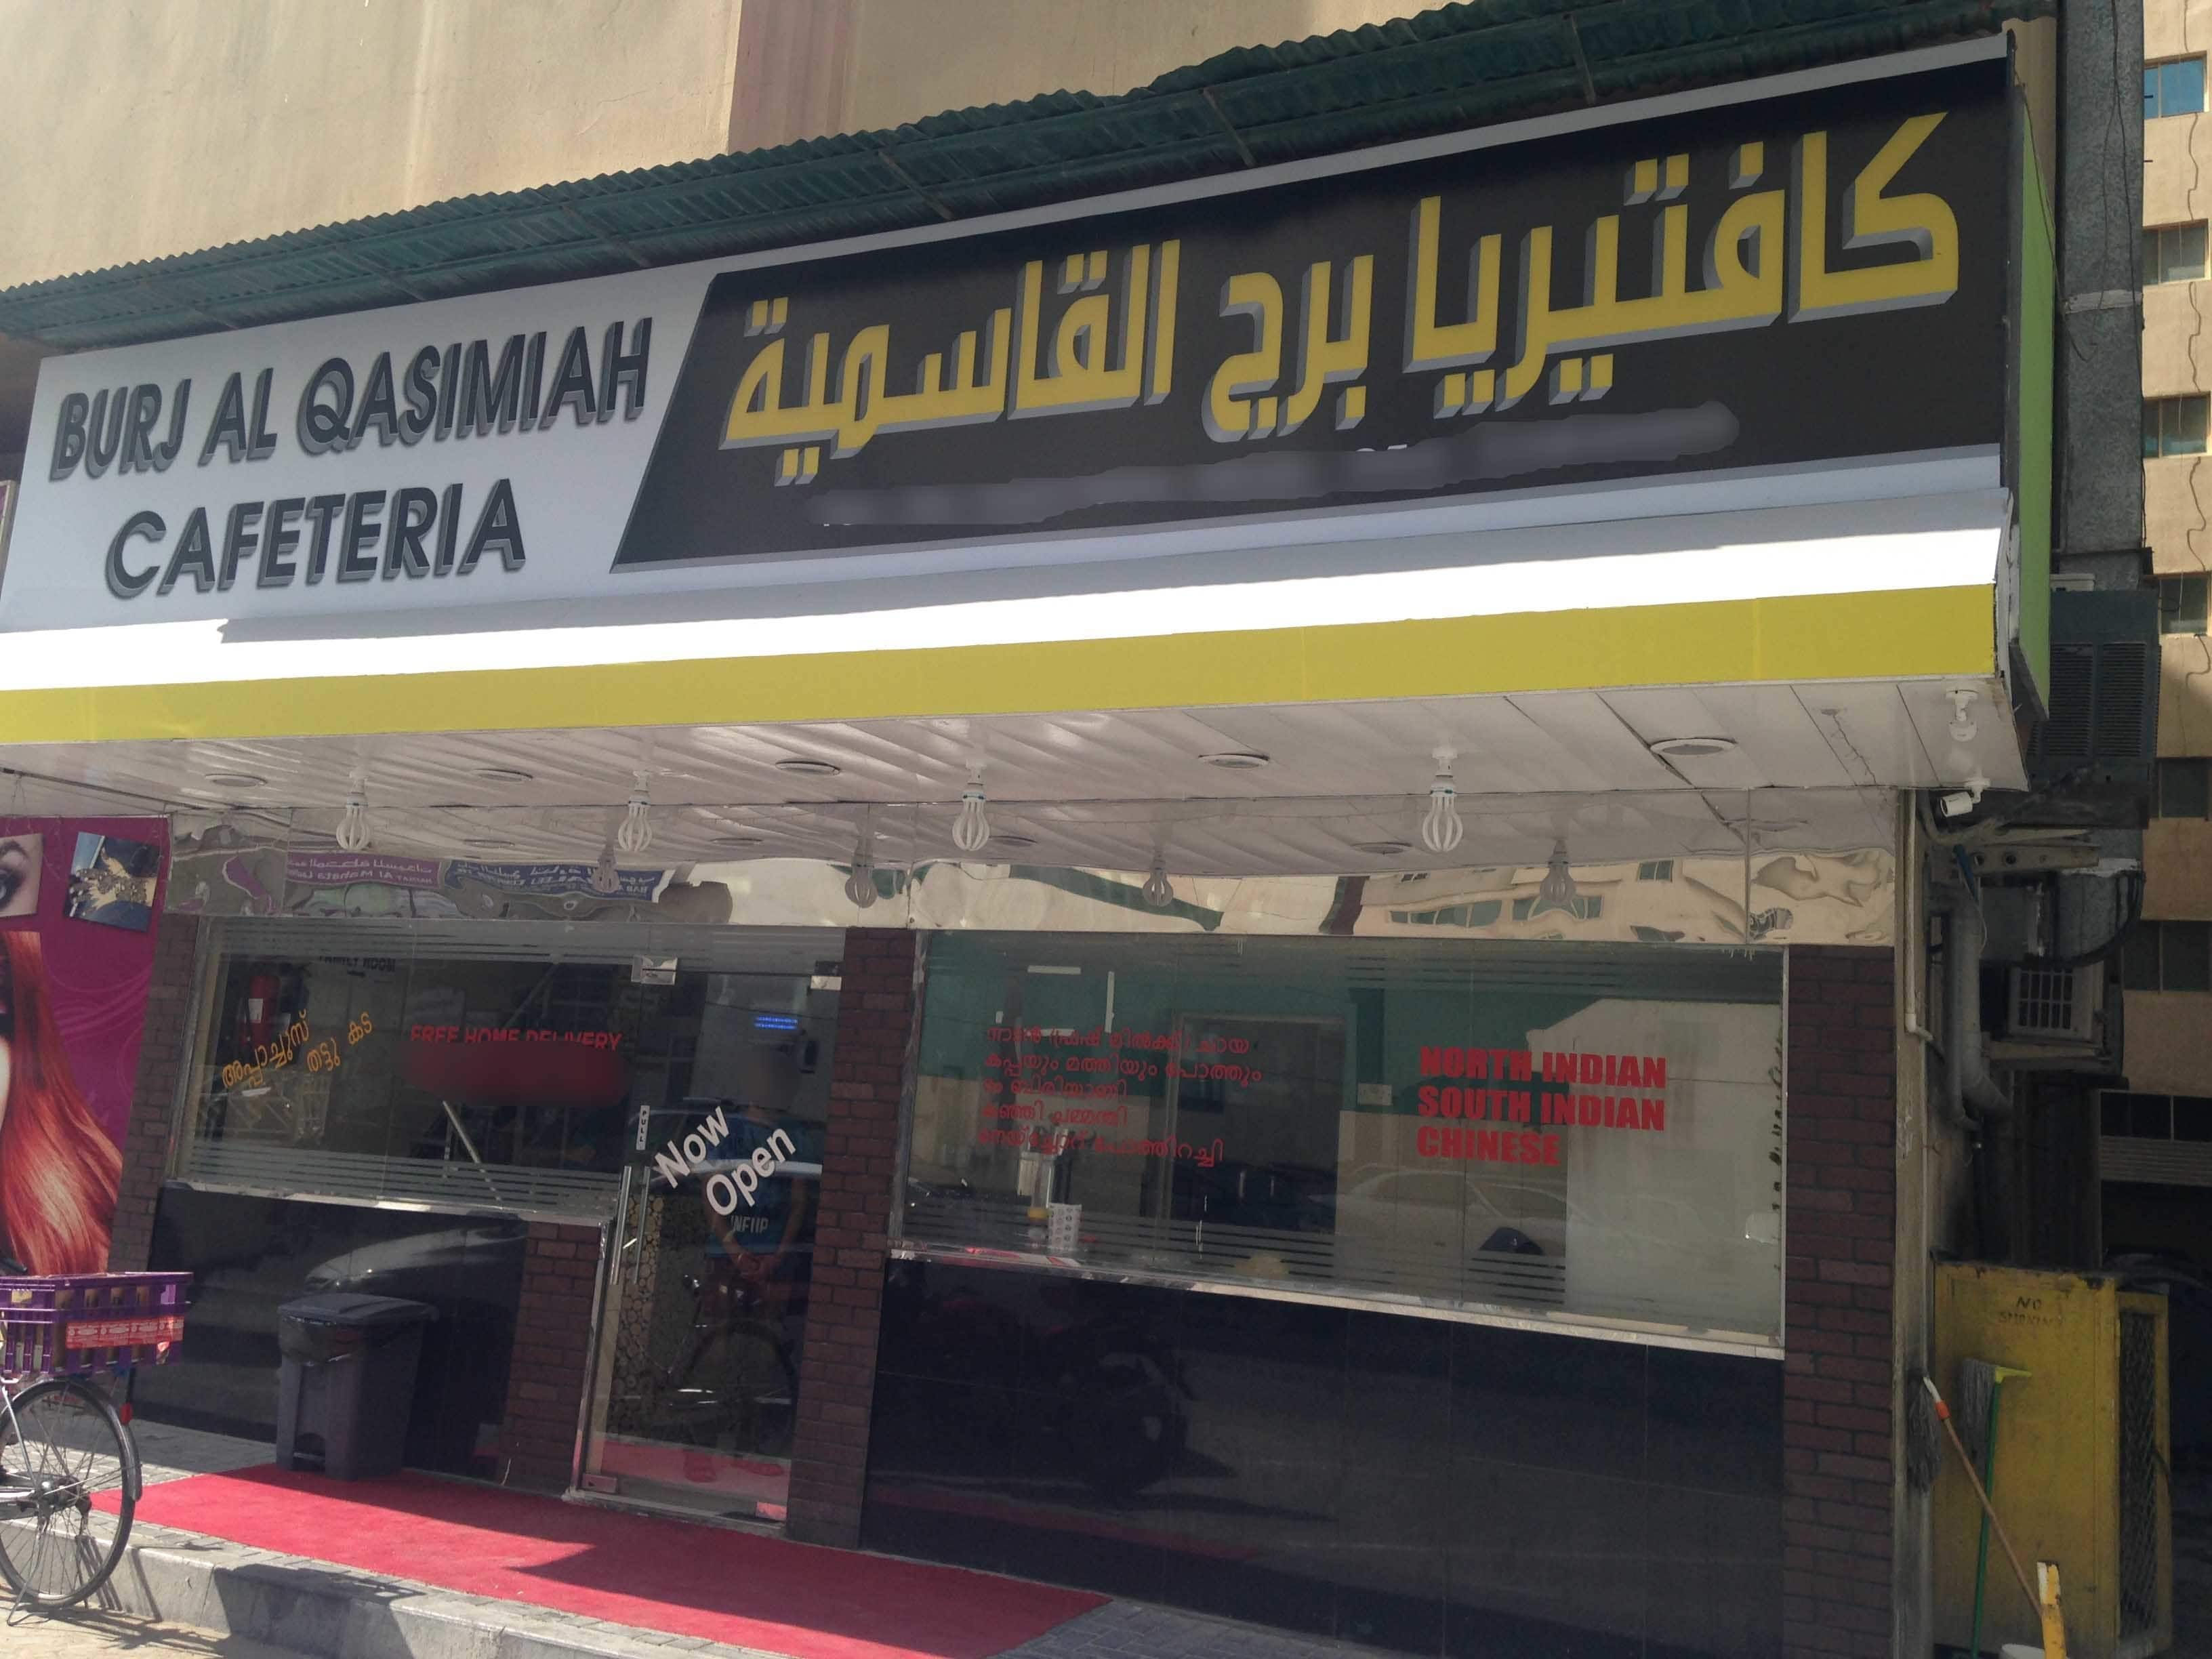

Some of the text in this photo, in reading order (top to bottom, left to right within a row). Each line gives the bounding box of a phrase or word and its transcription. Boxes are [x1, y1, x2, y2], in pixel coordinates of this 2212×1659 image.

[718, 112, 1959, 487] كافتيريا برج القاسمية
[49, 317, 652, 482] BURJ AL QASIMIAH
[105, 478, 527, 599] CAFETERIA
[348, 1011, 373, 1045] കട
[411, 1024, 623, 1050] FREE HOME DELIVERY
[1420, 1046, 1666, 1089] NORTH INDIAN
[1417, 1086, 1664, 1131] SOUTH INDIAN
[654, 1105, 731, 1189] Now
[1416, 1126, 1559, 1166] CHINESE
[706, 1128, 796, 1216] Open
[2016, 1296, 2042, 1310] NO
